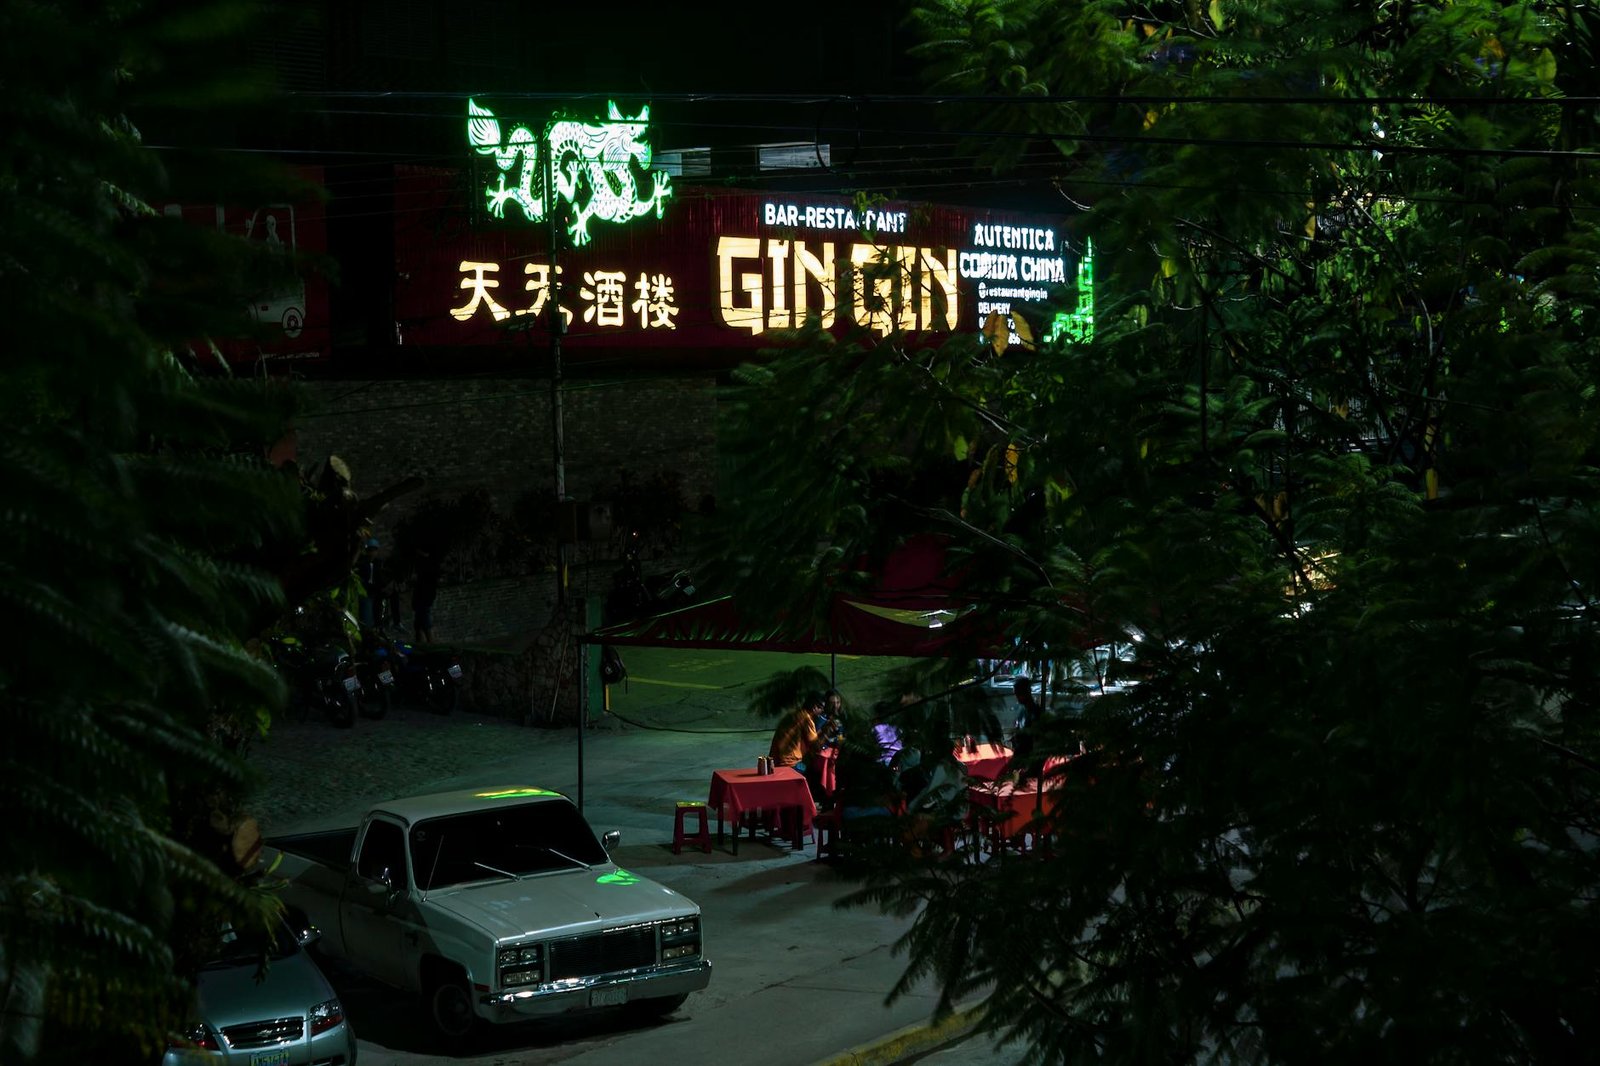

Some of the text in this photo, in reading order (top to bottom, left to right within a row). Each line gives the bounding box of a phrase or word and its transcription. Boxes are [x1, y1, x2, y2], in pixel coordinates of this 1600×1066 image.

[765, 203, 907, 233] BAR-RESTARANT
[974, 223, 1055, 251] AUTENTICA
[960, 252, 1066, 283] COMIDA CHINA
[717, 236, 959, 338] GIN GIN
